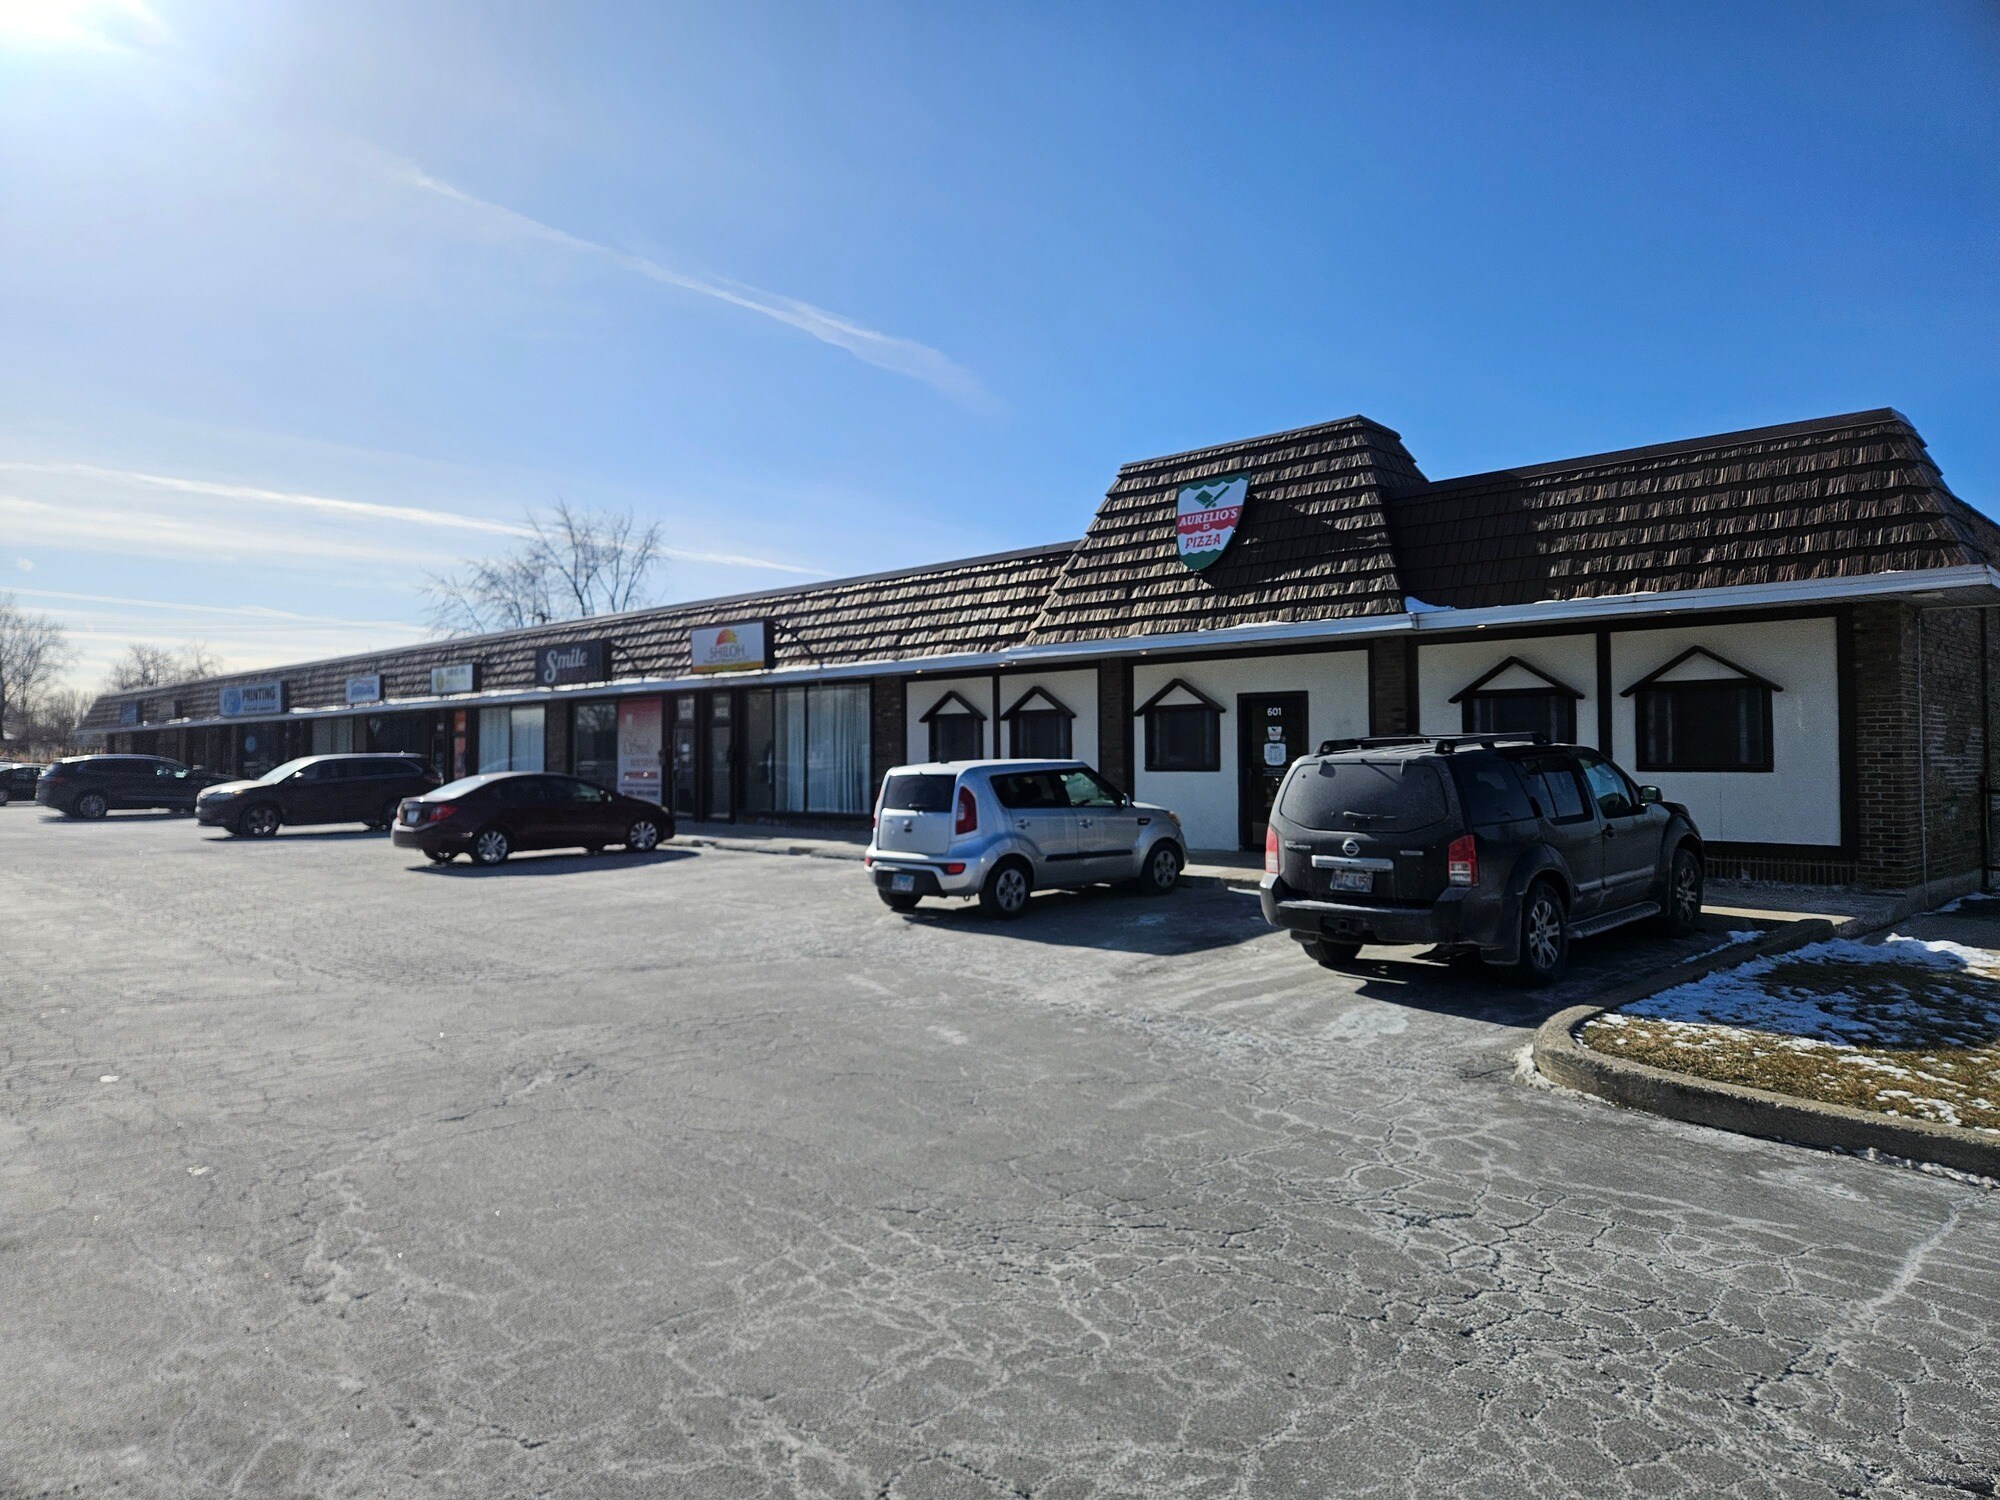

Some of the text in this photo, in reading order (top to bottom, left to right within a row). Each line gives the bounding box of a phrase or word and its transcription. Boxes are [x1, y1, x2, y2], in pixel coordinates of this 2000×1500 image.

[1179, 508, 1238, 526] AURELIO'S
[1185, 533, 1221, 549] PIZZA
[544, 648, 588, 683] Smile
[1267, 707, 1281, 716] 601
